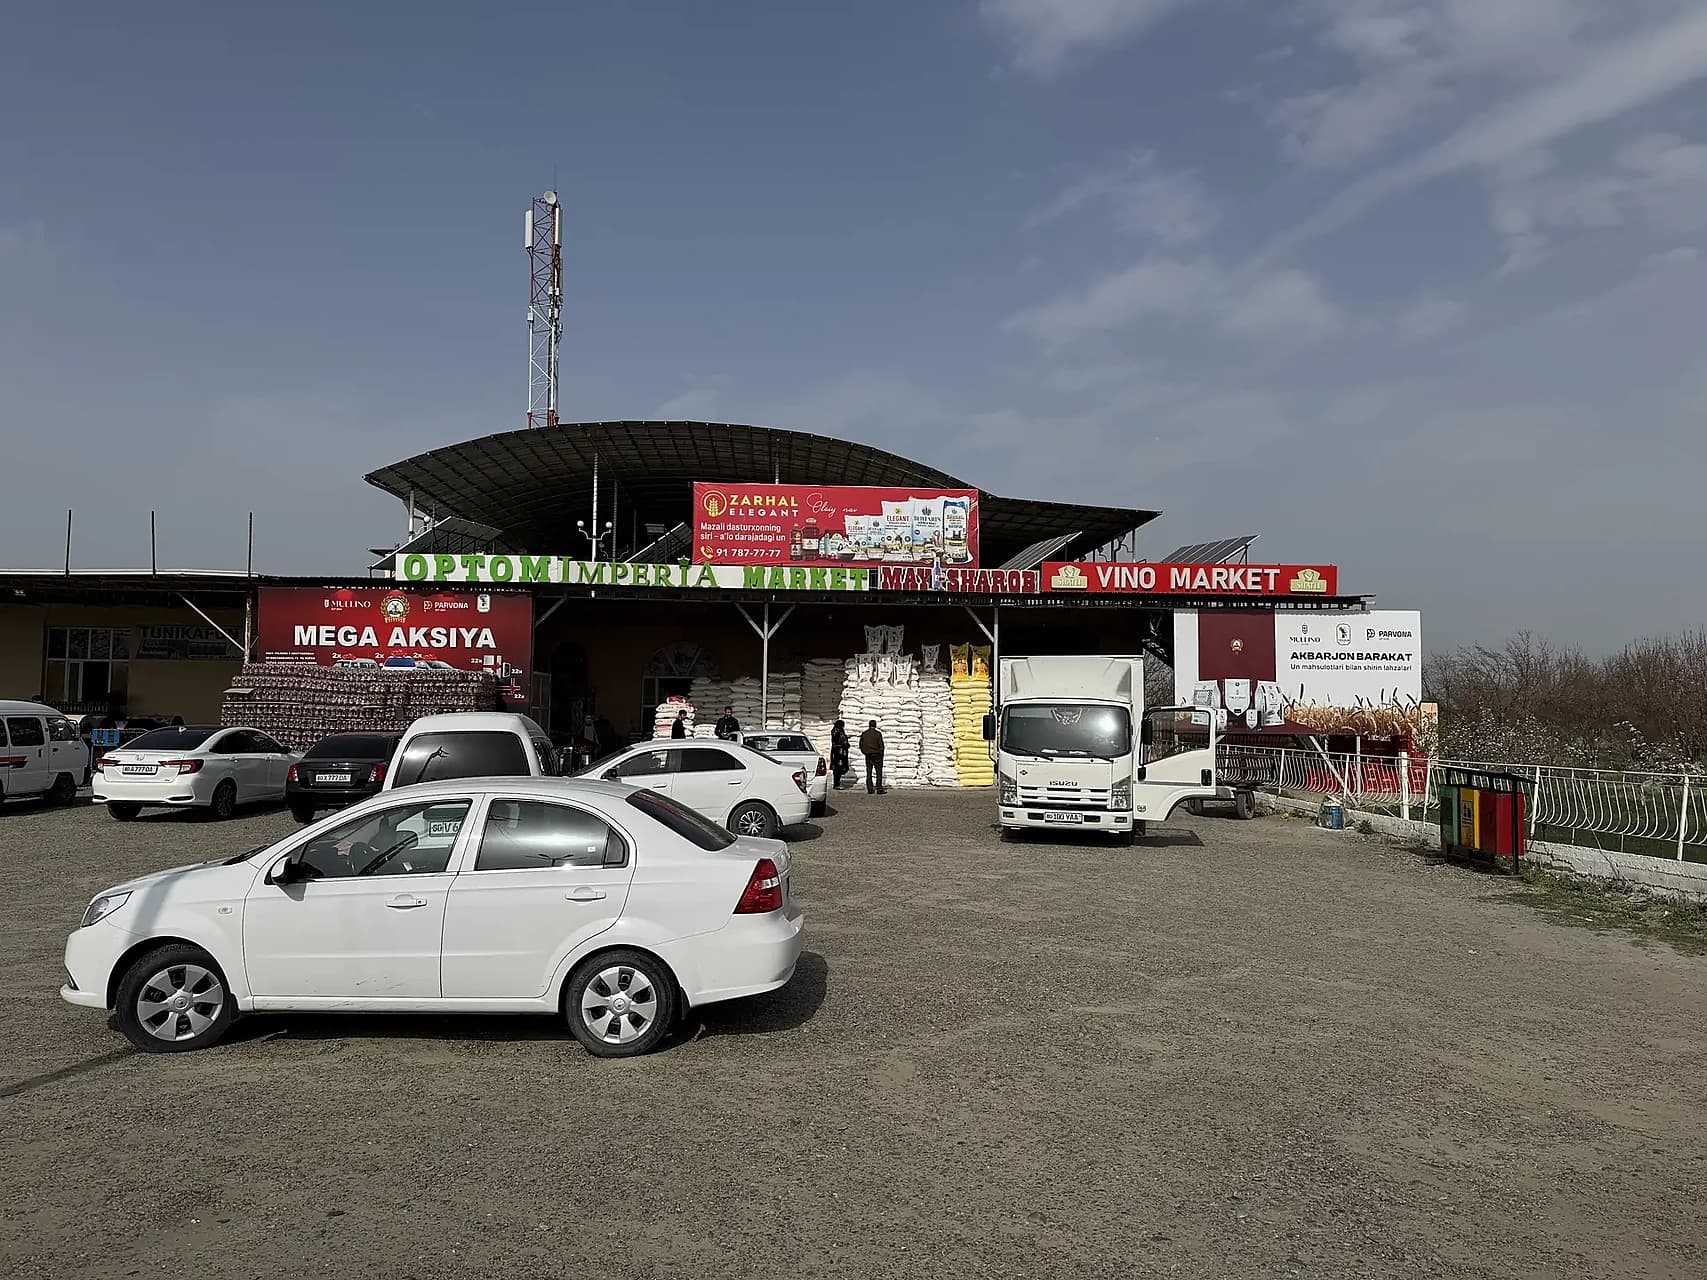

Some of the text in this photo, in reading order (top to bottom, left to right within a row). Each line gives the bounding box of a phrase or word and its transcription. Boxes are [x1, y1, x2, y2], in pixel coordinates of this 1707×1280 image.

[730, 494, 799, 507] ZARHAL
[729, 508, 799, 517] ELEGANT
[700, 522, 781, 533] Mazali dasturxonning
[700, 532, 713, 541] siri
[735, 533, 775, 543] darajadagi
[716, 548, 781, 558] 91 787-77-77
[404, 553, 552, 582] OPTOM
[742, 566, 869, 590] MARKET
[946, 569, 1037, 592] SHAROB
[1096, 565, 1281, 592] VINO MARKET
[434, 601, 469, 609] PARVONA
[294, 625, 497, 649] MEGA AKSIYA
[1378, 630, 1412, 638] PARVONA
[1290, 652, 1412, 661] AKBARJON BARAKAT
[1302, 663, 1344, 671] mahsulotlari
[1345, 663, 1361, 671] bilan
